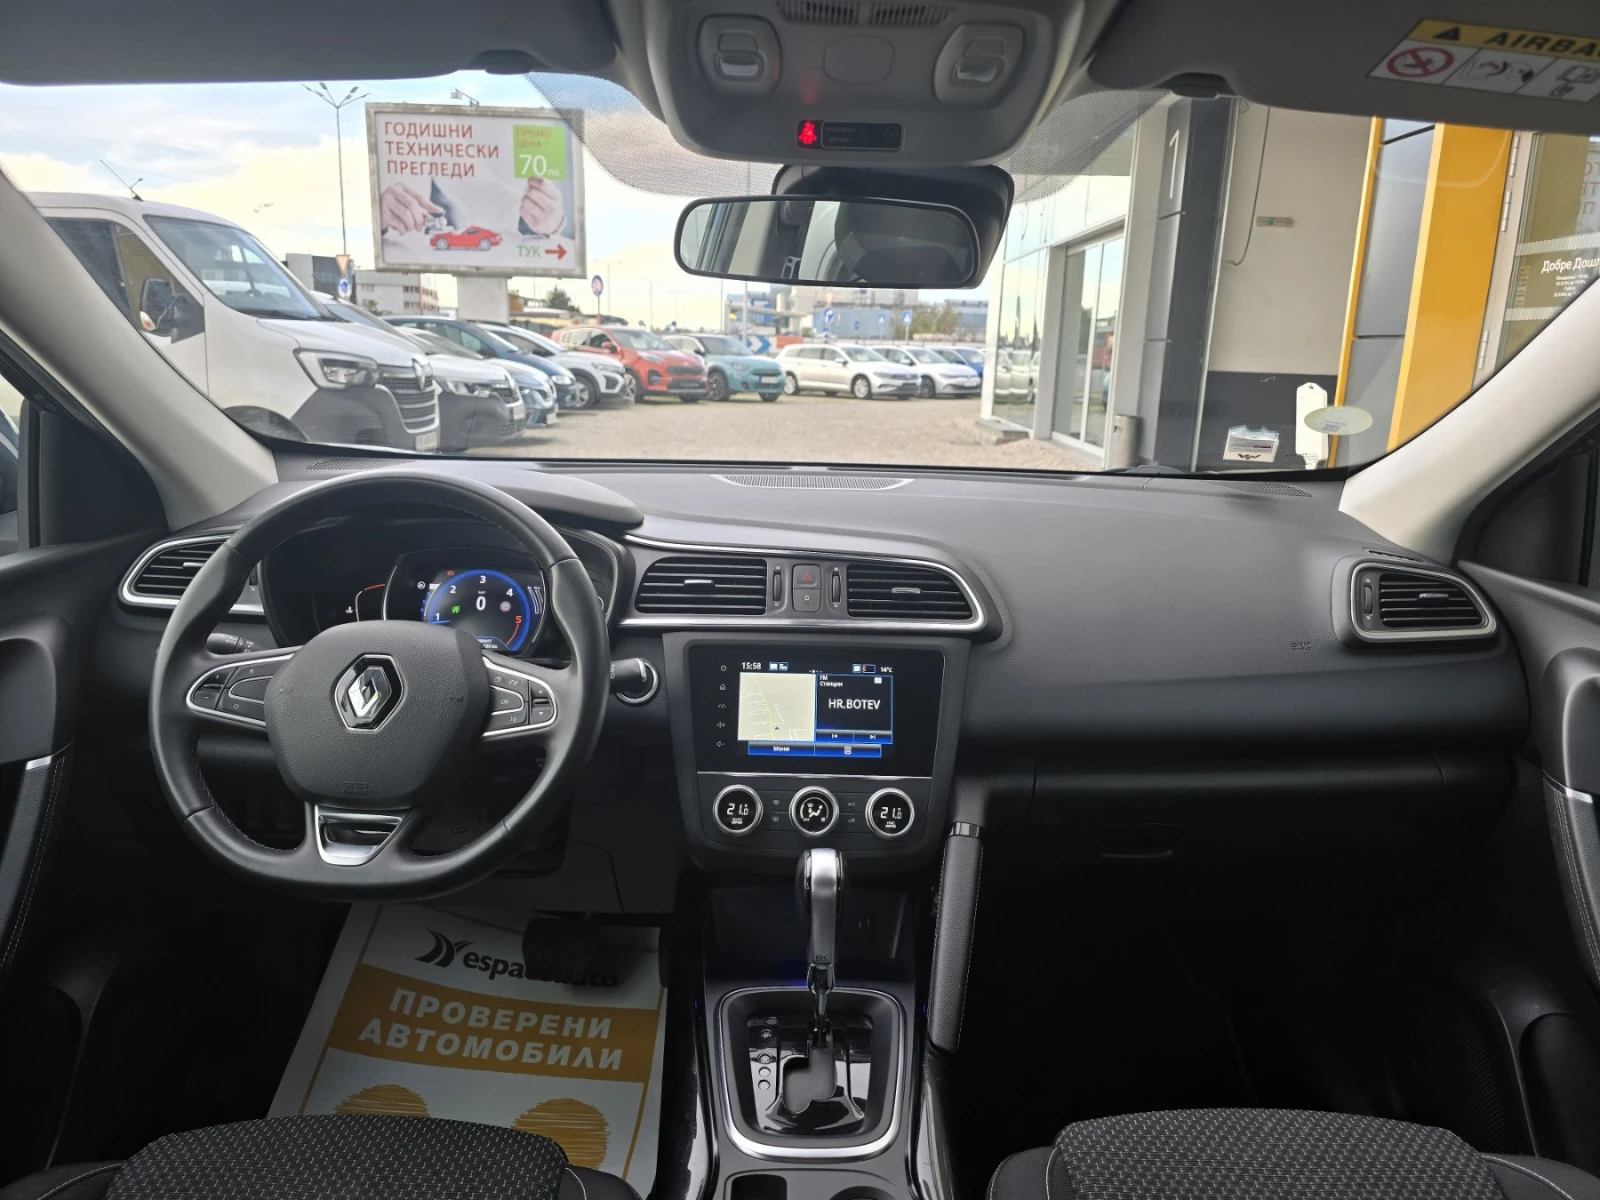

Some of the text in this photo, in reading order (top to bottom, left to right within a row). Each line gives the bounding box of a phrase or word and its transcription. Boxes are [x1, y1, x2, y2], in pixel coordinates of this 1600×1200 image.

[1484, 31, 1600, 58] AIRBA
[384, 121, 473, 139] ГОДИШНИ
[516, 127, 551, 138] ПРОМО
[384, 141, 499, 159] ТЕХНИЧЕСКИ
[516, 139, 542, 149] ЦЕНА
[387, 160, 475, 179] ПРЕГЛЕДИ
[519, 153, 547, 176] 70
[1168, 129, 1180, 199] 1
[517, 245, 541, 258] ТУК
[1541, 259, 1572, 274] Добре
[479, 575, 486, 584] 3
[450, 585, 457, 594] 2
[506, 588, 514, 597] 4
[476, 596, 486, 611] 0
[434, 613, 440, 621] 1
[515, 615, 522, 624] 5
[741, 662, 762, 670] 15:58
[828, 698, 881, 710] HR.BOTEV
[389, 987, 612, 1040] ПРОВЕРЕНИ
[358, 1018, 623, 1071] АВТОМОБИЛИ
